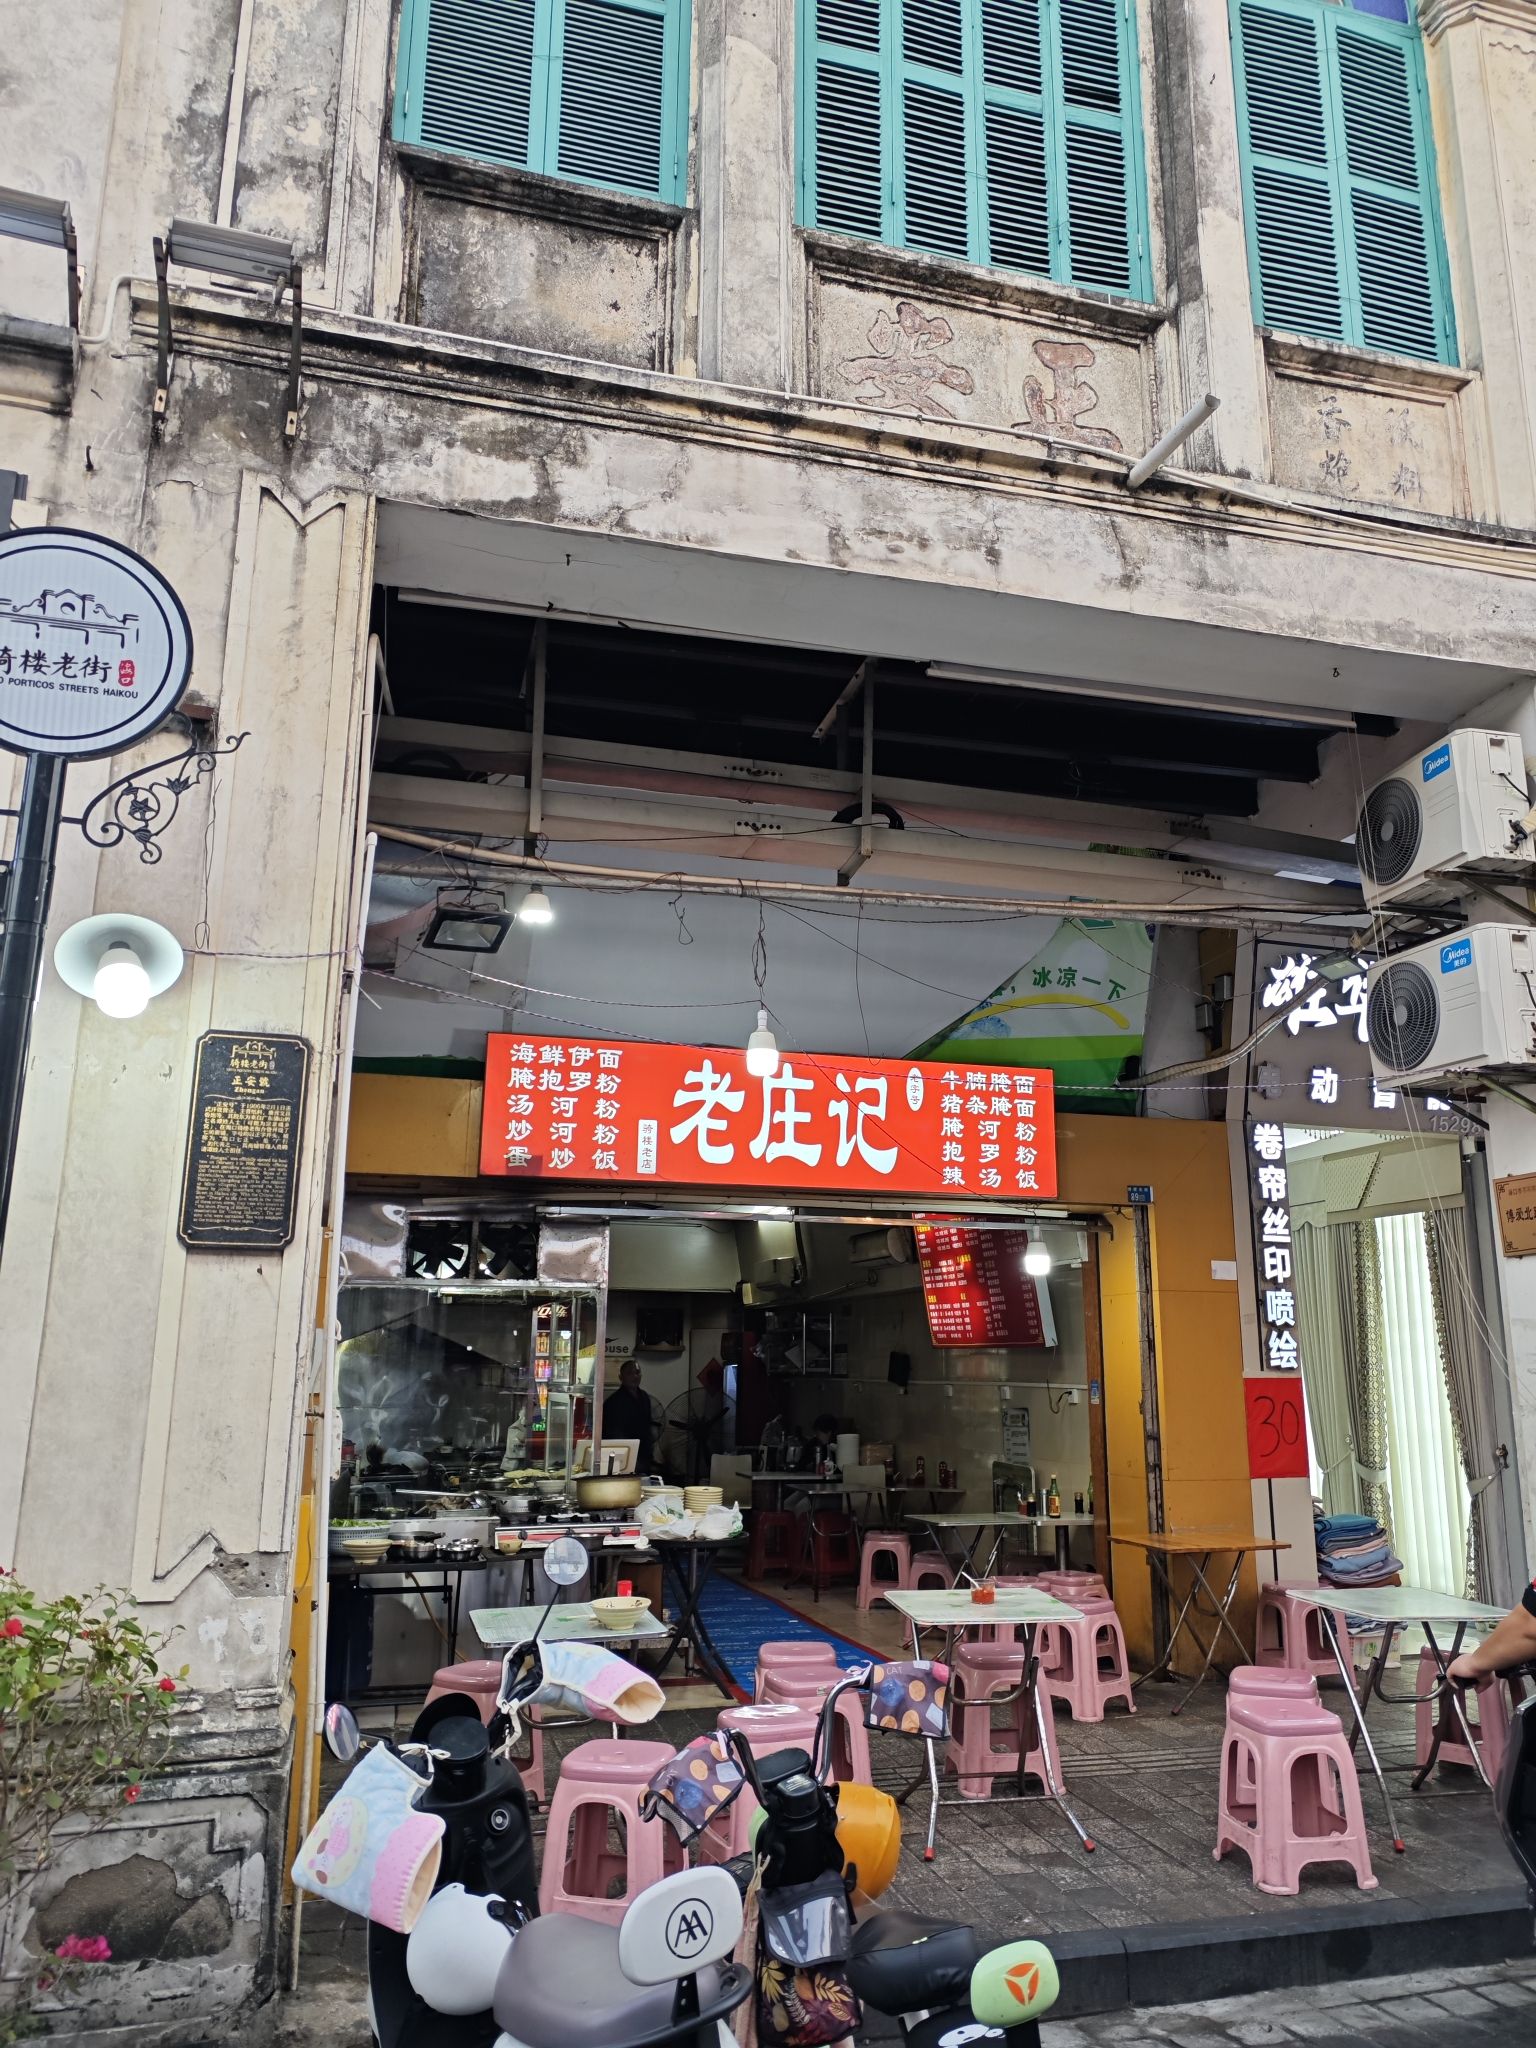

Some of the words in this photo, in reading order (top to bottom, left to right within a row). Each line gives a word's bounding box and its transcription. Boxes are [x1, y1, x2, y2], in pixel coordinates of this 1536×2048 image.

[8, 677, 55, 690] PORTICOS
[59, 683, 99, 695] STREETS
[103, 687, 139, 699] HAIKOU
[1425, 755, 1449, 775] Midea
[1443, 947, 1470, 964] Midea
[510, 1042, 623, 1069] 海鲜伊面
[507, 1067, 622, 1094] 腌抱罗粉
[910, 1074, 920, 1105] 老字号
[940, 1070, 1036, 1094] 牛腩腌面
[506, 1094, 621, 1120] 汤河粉
[669, 1058, 899, 1174] 老庄记
[940, 1093, 1036, 1118] 猪杂腌面
[505, 1119, 620, 1145] 炒河粉
[940, 1117, 1038, 1141] 腌河粉
[503, 1146, 619, 1171] 蛋炒饭
[642, 1124, 654, 1169] 骑楼老店
[941, 1140, 1038, 1165] 抱罗粉
[941, 1165, 1039, 1189] 辣汤饭
[1253, 1123, 1299, 1369] 卷帘丝印喷绘
[1254, 1395, 1300, 1458] 30
[886, 1666, 903, 1675] CAT
